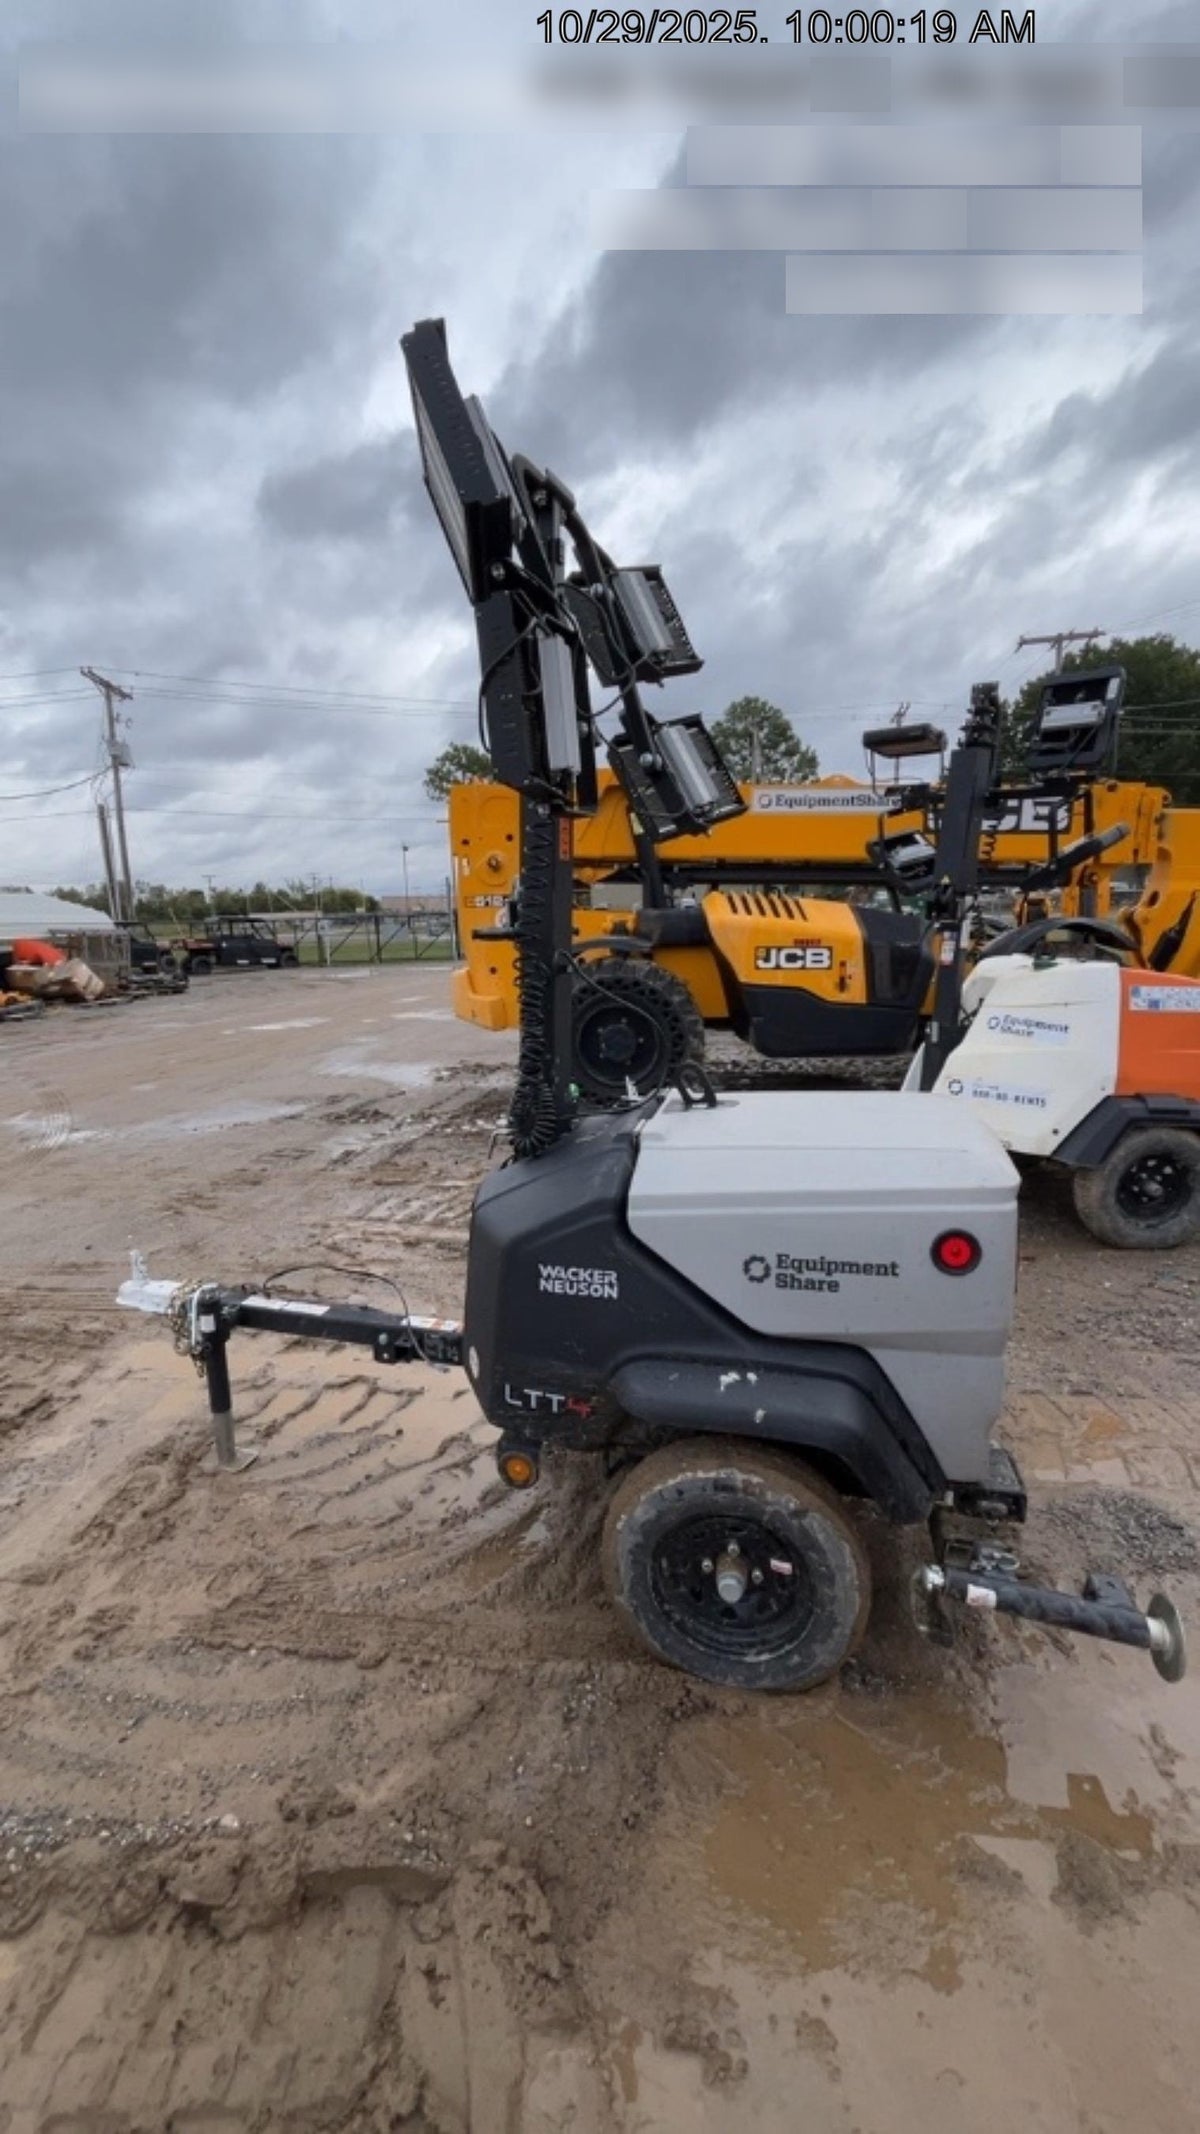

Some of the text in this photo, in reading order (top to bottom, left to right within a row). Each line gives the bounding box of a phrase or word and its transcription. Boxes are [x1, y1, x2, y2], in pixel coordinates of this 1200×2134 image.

[756, 947, 831, 969] JCB
[538, 1263, 618, 1284] WACKER
[776, 1253, 899, 1277] Equipment
[540, 1277, 618, 1300] NEUSON
[775, 1272, 840, 1293] Share
